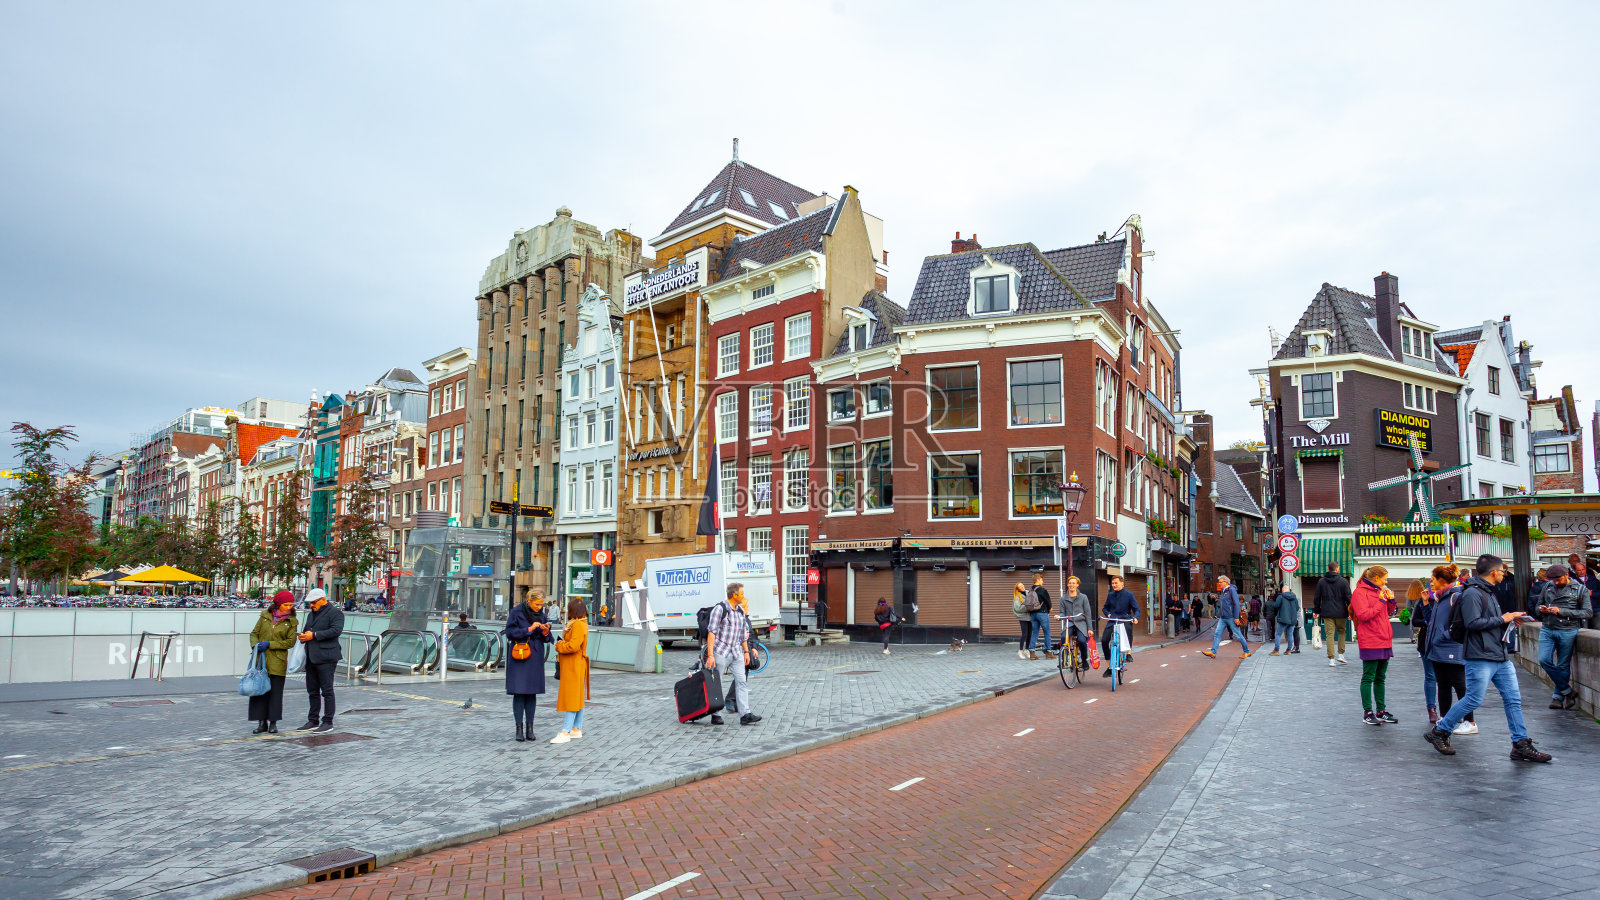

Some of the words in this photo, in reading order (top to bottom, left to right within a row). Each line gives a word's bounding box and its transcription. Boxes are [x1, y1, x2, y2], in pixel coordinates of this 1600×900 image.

[626, 261, 699, 295] NOORDNEDERLANDS
[1381, 410, 1430, 428] DIAMOND
[1290, 435, 1317, 448] The
[1321, 432, 1350, 446] Mill
[1298, 514, 1349, 525] Diamonds
[828, 541, 858, 549] BRASSERIE
[995, 538, 1033, 546] MEUWESE
[1359, 535, 1406, 546] DIAMOND
[659, 568, 710, 585] DutchNed
[108, 639, 204, 665] Rokin
